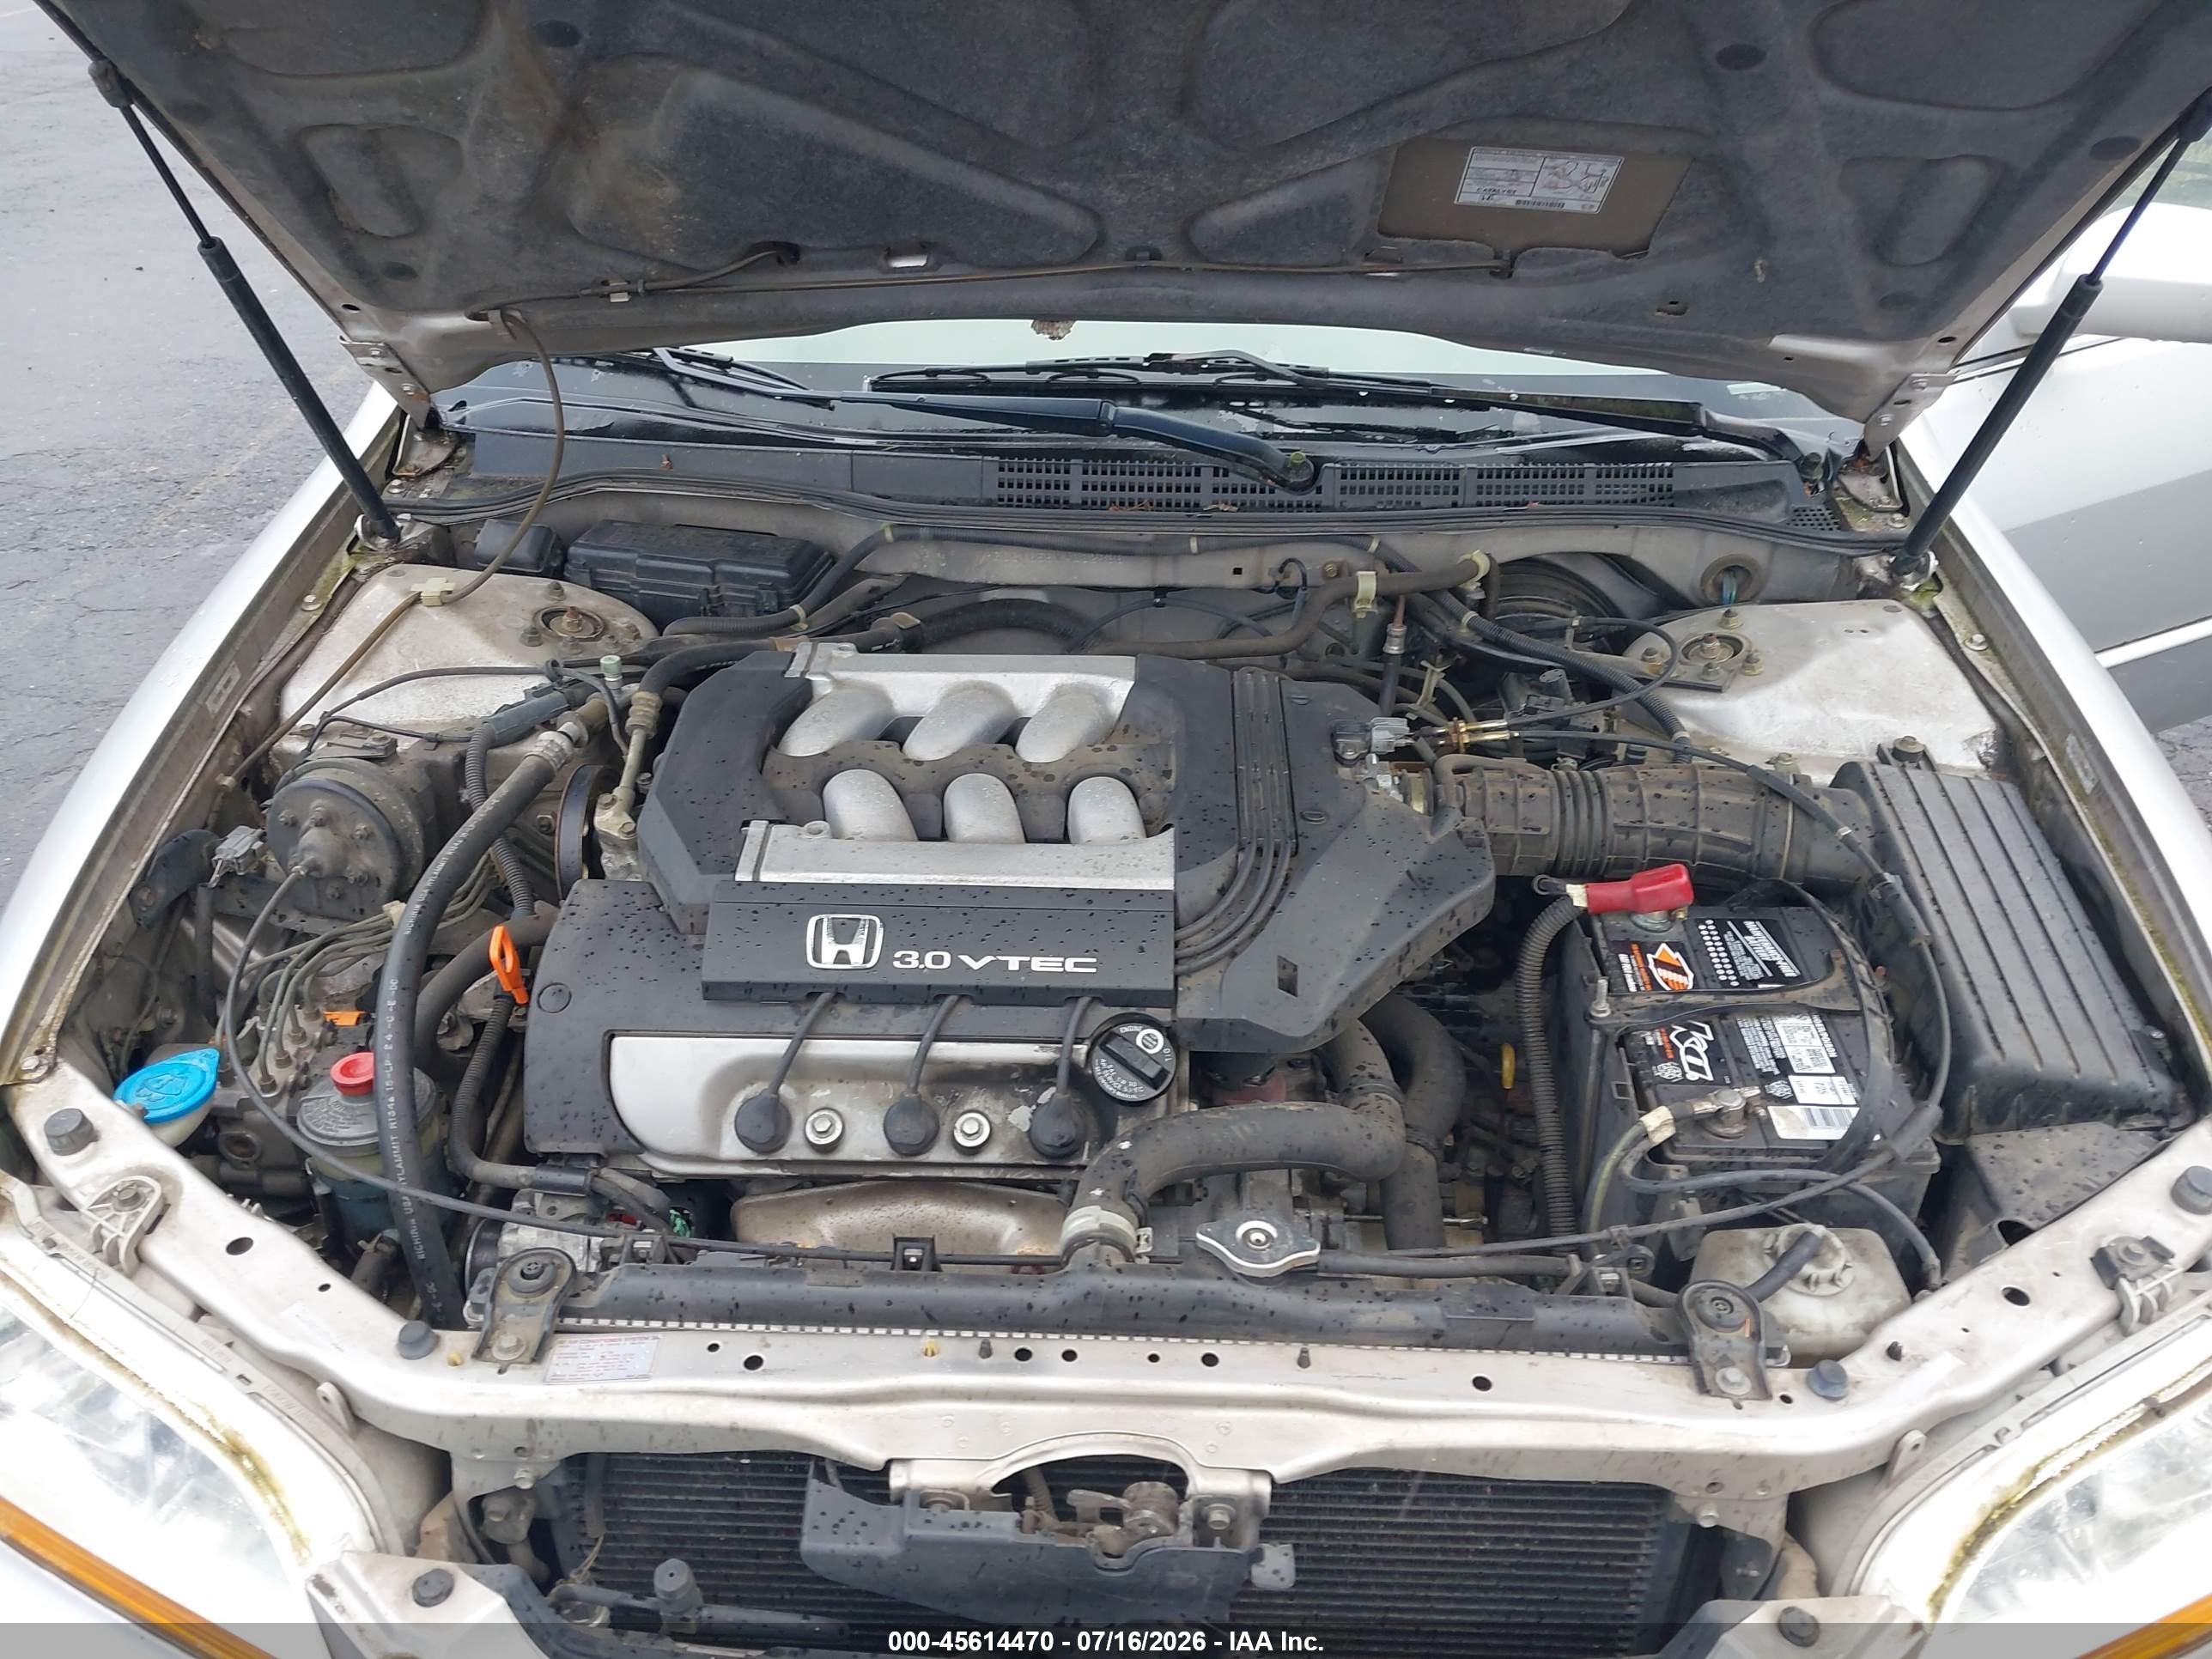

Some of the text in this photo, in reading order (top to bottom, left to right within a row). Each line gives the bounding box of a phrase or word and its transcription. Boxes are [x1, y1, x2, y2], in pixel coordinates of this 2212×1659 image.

[892, 950, 1097, 973] 3.0 VTEC
[1163, 1048, 1172, 1061] OIL
